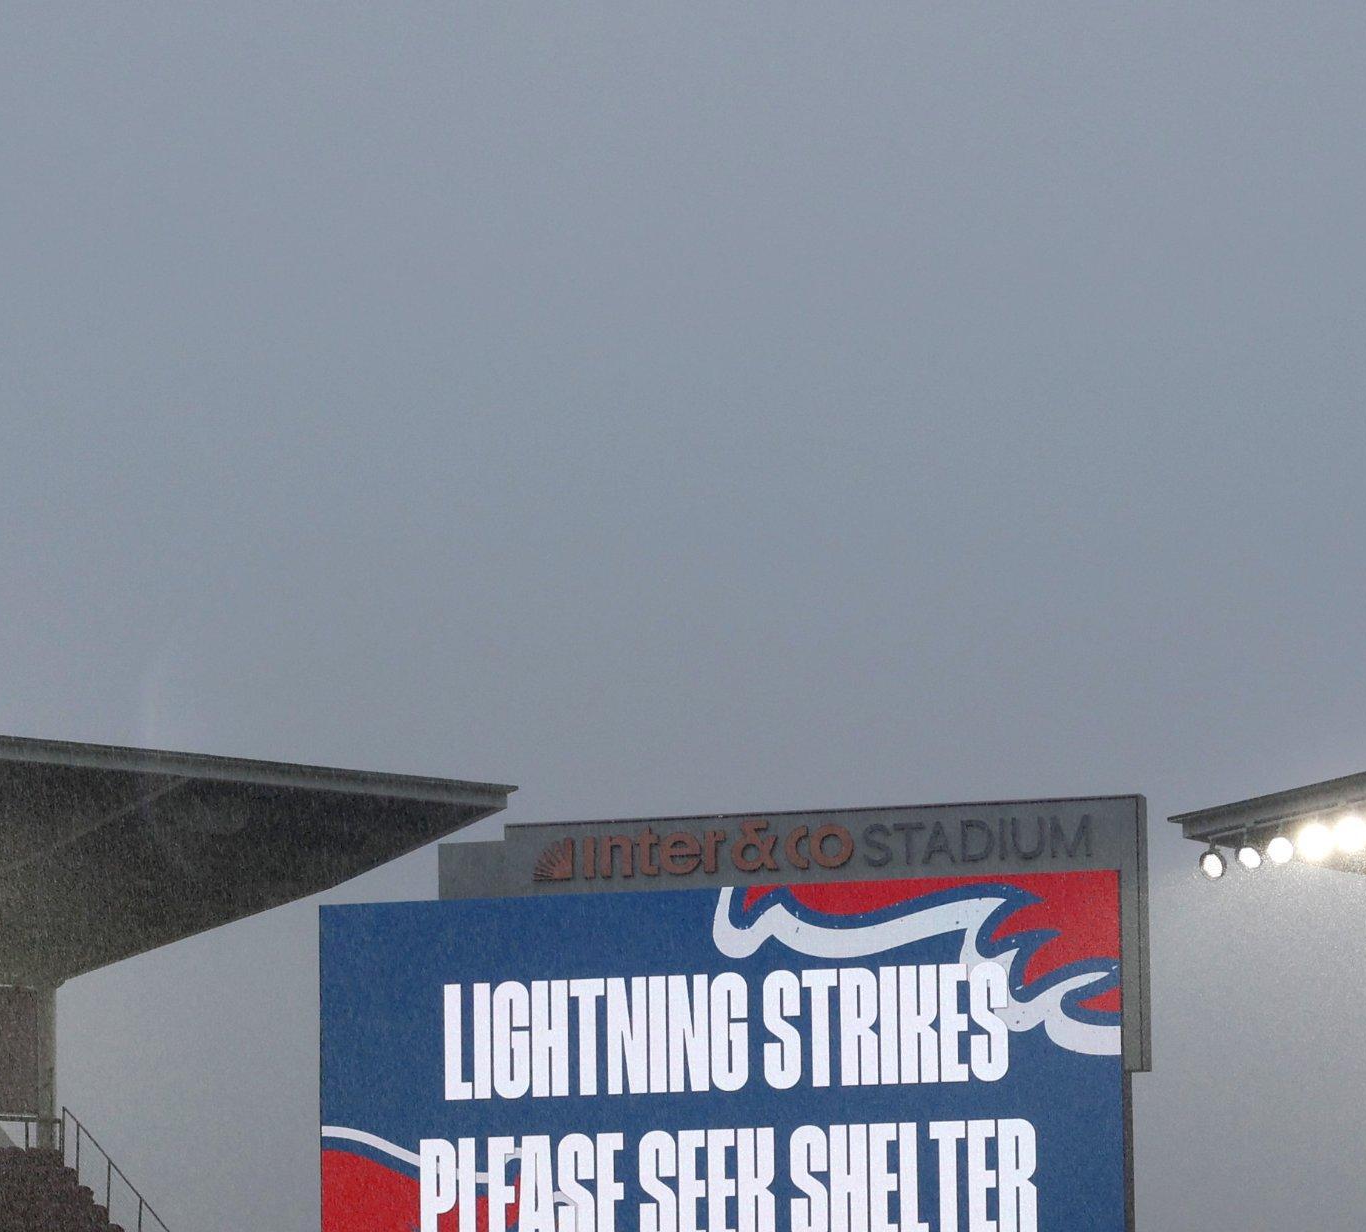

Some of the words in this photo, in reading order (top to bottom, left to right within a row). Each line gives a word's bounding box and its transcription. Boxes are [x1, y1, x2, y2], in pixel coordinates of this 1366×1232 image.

[863, 813, 1093, 868] STADIUM
[443, 971, 749, 1101] LIGHTNING
[763, 962, 1010, 1090] STRIKES
